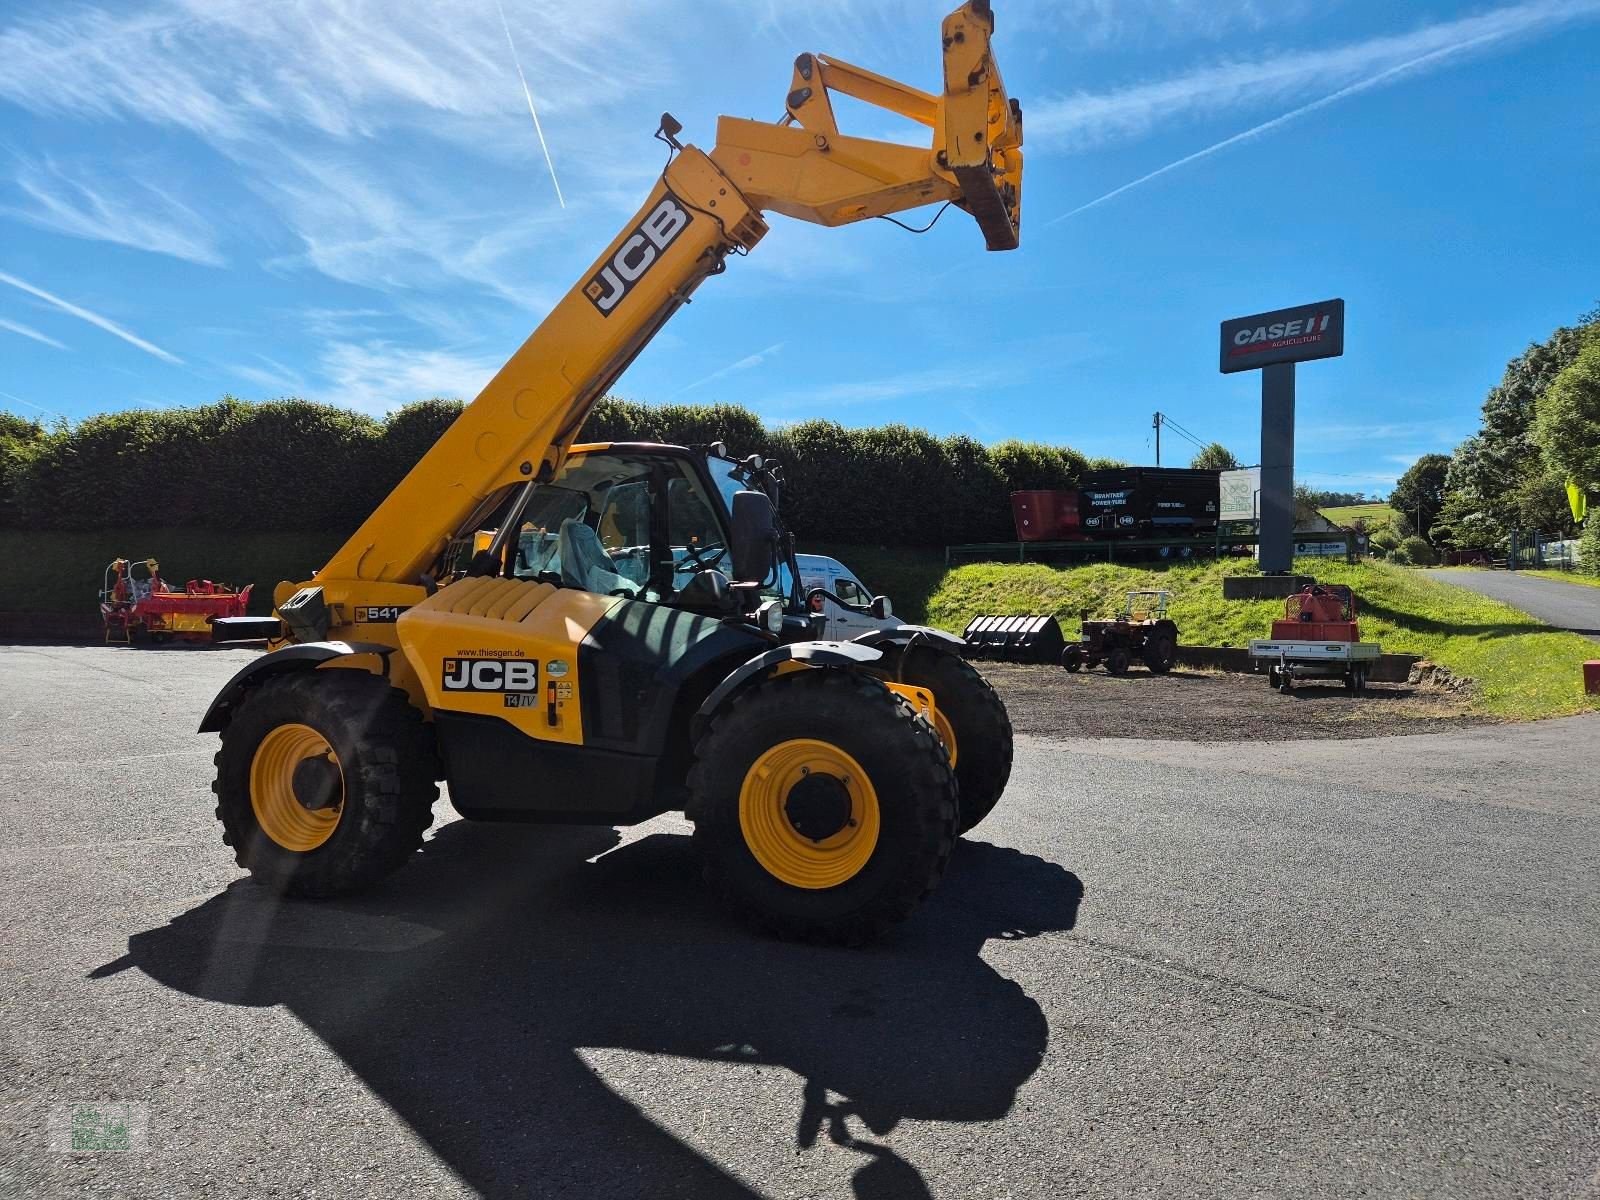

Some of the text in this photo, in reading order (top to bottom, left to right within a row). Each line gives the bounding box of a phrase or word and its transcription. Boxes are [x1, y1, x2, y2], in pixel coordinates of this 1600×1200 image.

[597, 200, 687, 310] JCB
[1234, 320, 1303, 345] CASE
[1271, 334, 1321, 348] AGRICULTURE
[368, 607, 398, 619] 541
[457, 648, 525, 659] www.thiesgen.de
[444, 660, 537, 691] JCB
